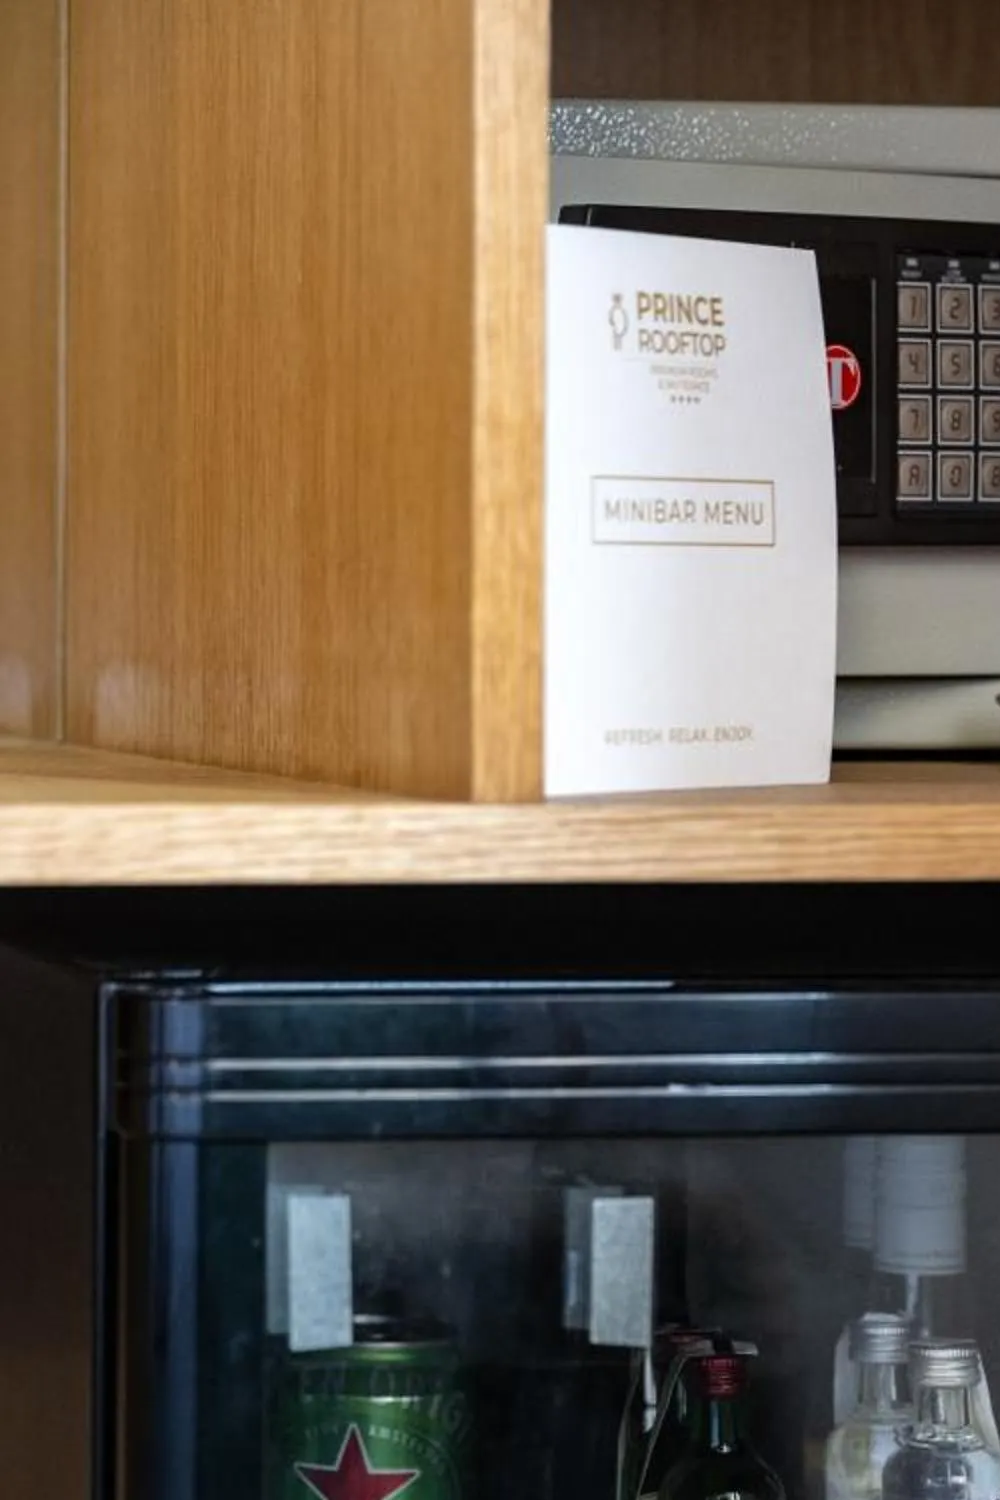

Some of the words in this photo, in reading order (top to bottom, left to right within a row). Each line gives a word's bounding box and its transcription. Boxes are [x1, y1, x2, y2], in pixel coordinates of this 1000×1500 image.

[636, 291, 725, 326] PRINCE
[910, 295, 918, 320] 1
[949, 296, 962, 321] 2
[638, 328, 727, 357] ROOFTOP
[908, 352, 920, 375] 4
[950, 352, 961, 377] 5
[909, 407, 920, 432] 7
[950, 408, 962, 433] 8
[949, 464, 962, 489] 0
[604, 498, 697, 525] MINIBAR
[703, 500, 765, 526] MENU
